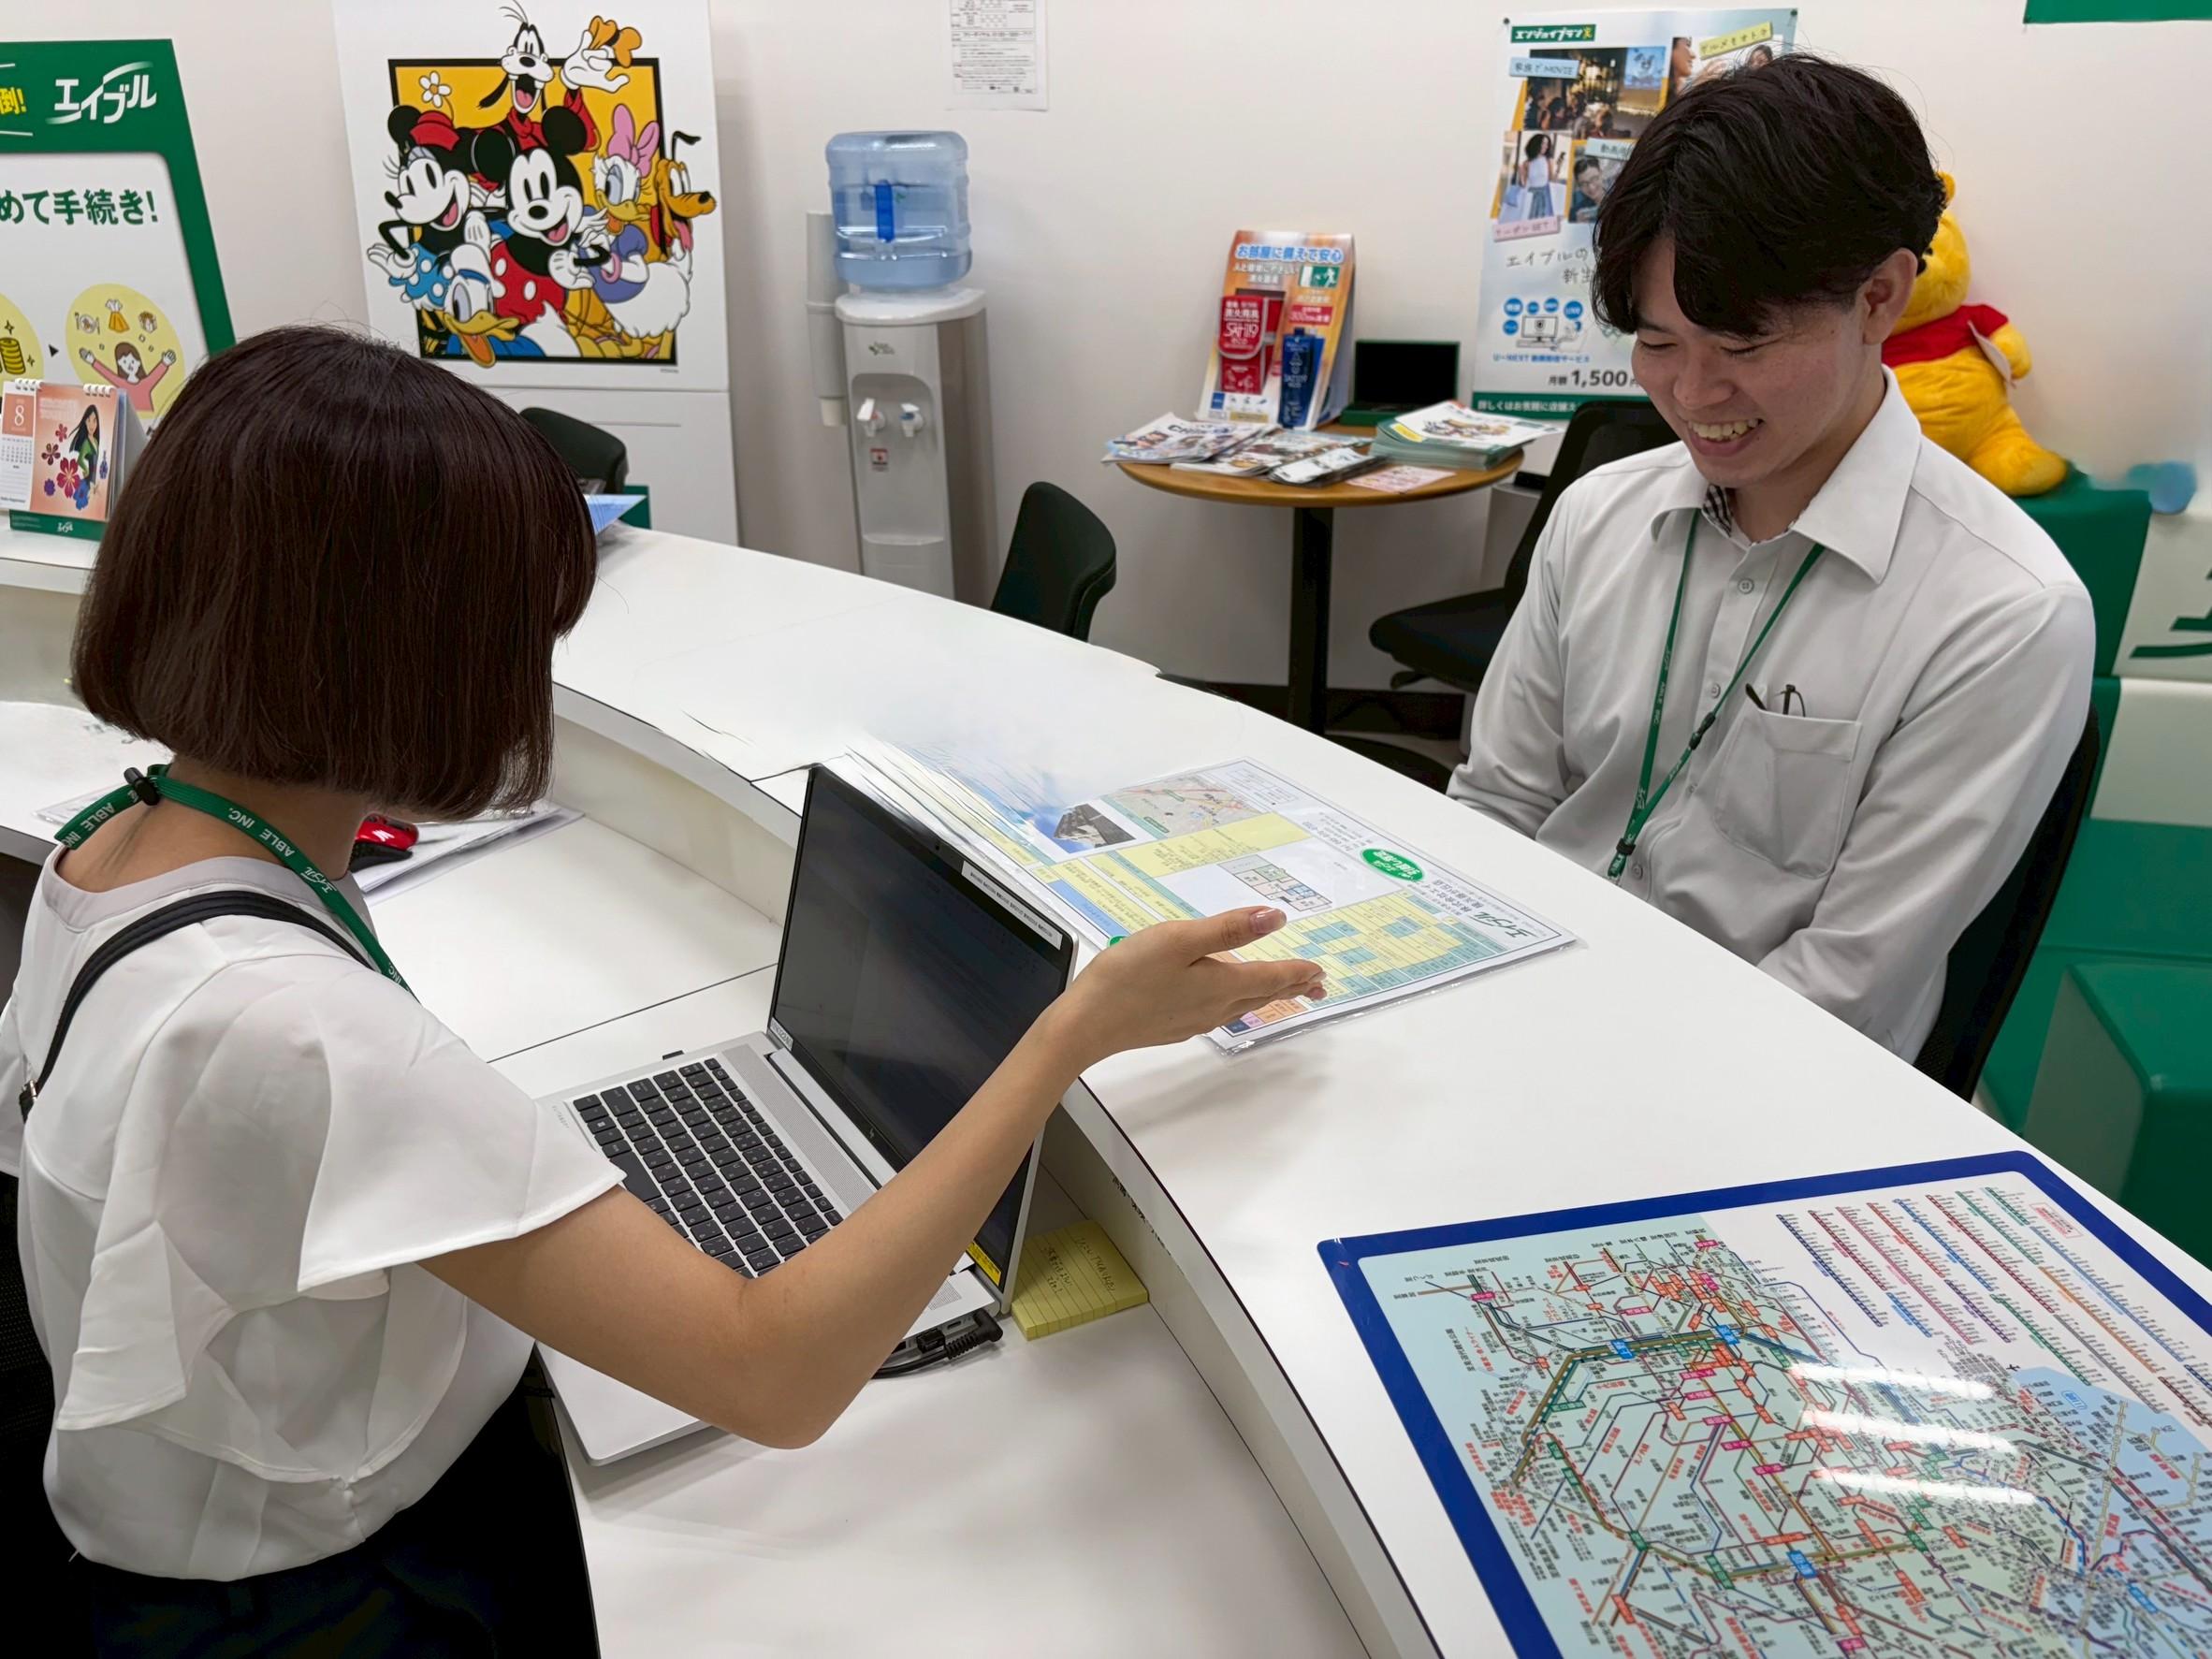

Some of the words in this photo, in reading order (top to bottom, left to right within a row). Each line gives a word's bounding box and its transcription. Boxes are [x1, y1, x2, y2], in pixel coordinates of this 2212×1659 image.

[47, 61, 157, 124] エイブル
[0, 188, 158, 226] めて手続き!
[1571, 370, 1628, 388] 1,500
[14, 405, 24, 426] 8
[80, 803, 115, 832] ABLE
[228, 808, 256, 829] INC.
[259, 828, 296, 858] ABLE
[1470, 910, 1540, 939] エイブル
